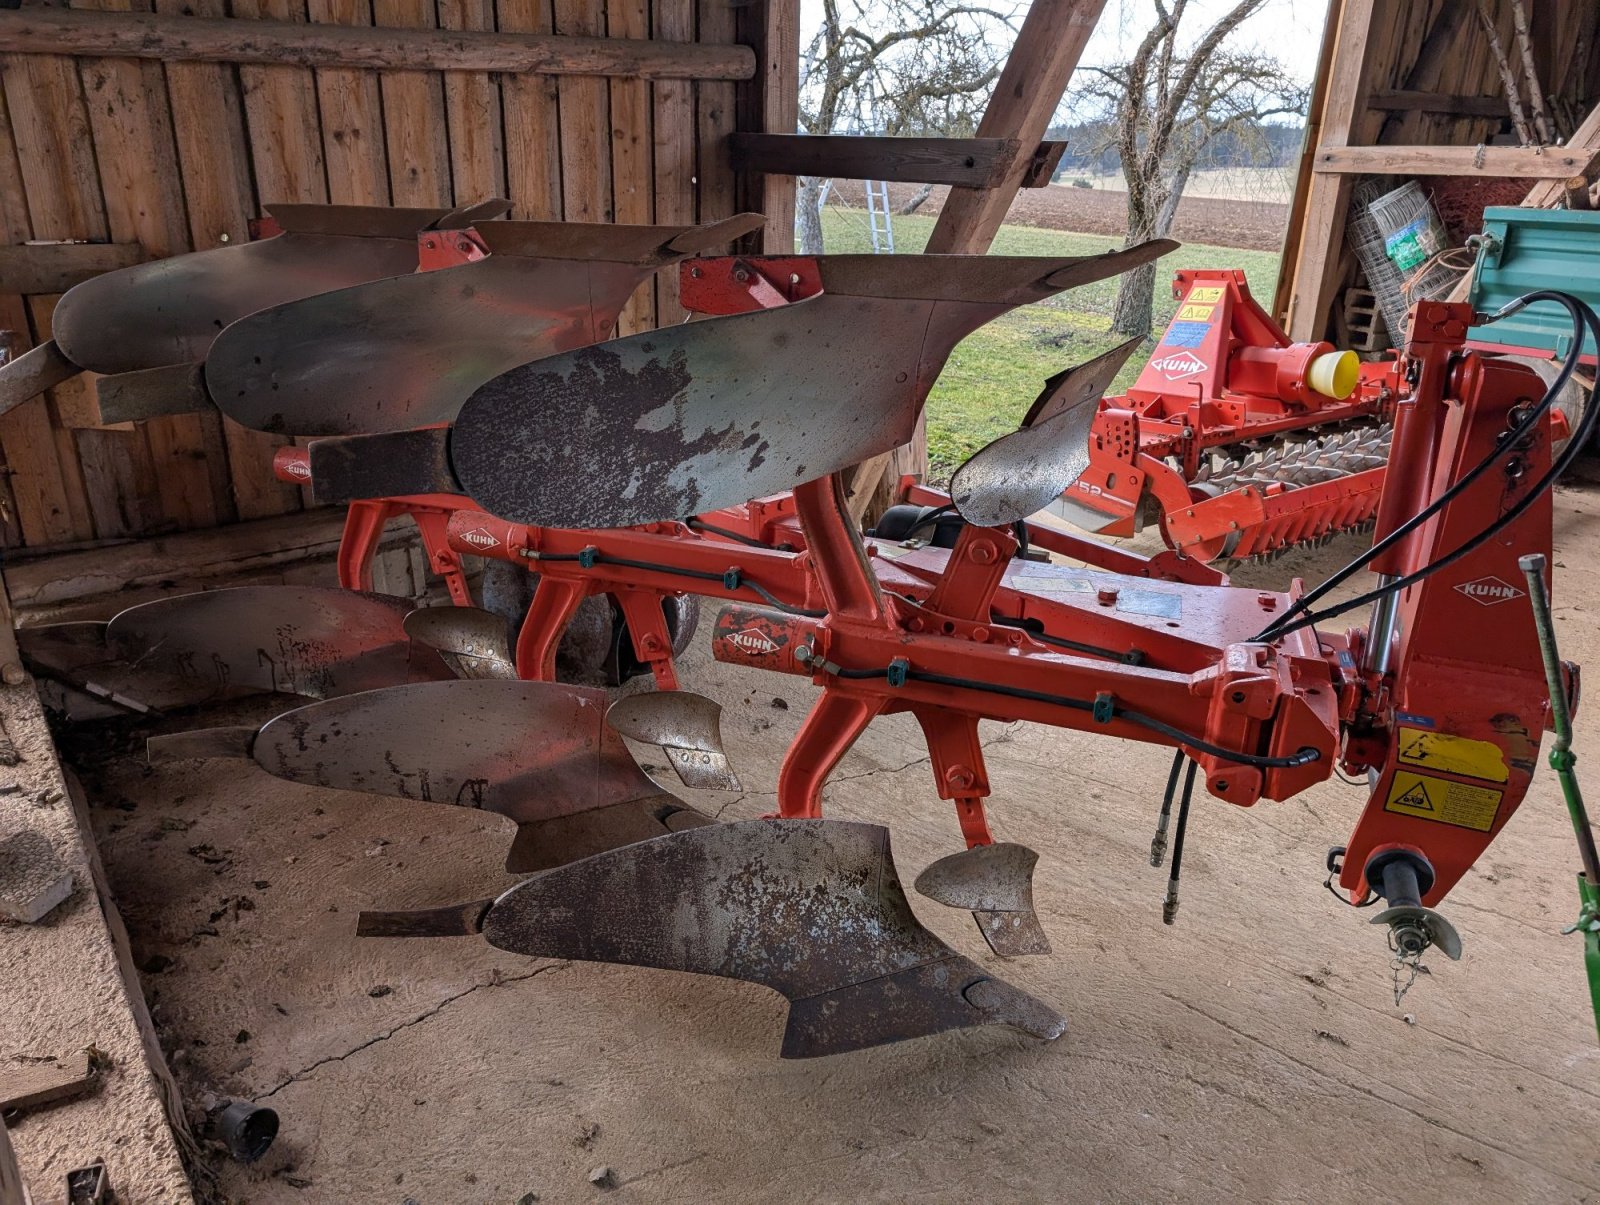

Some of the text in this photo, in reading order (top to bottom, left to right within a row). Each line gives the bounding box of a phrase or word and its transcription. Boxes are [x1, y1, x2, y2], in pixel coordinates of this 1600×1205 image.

[1159, 359, 1201, 372] KUHN
[466, 533, 494, 546] KUHN
[1464, 583, 1514, 598] KUHN
[734, 634, 772, 651] KUHN
